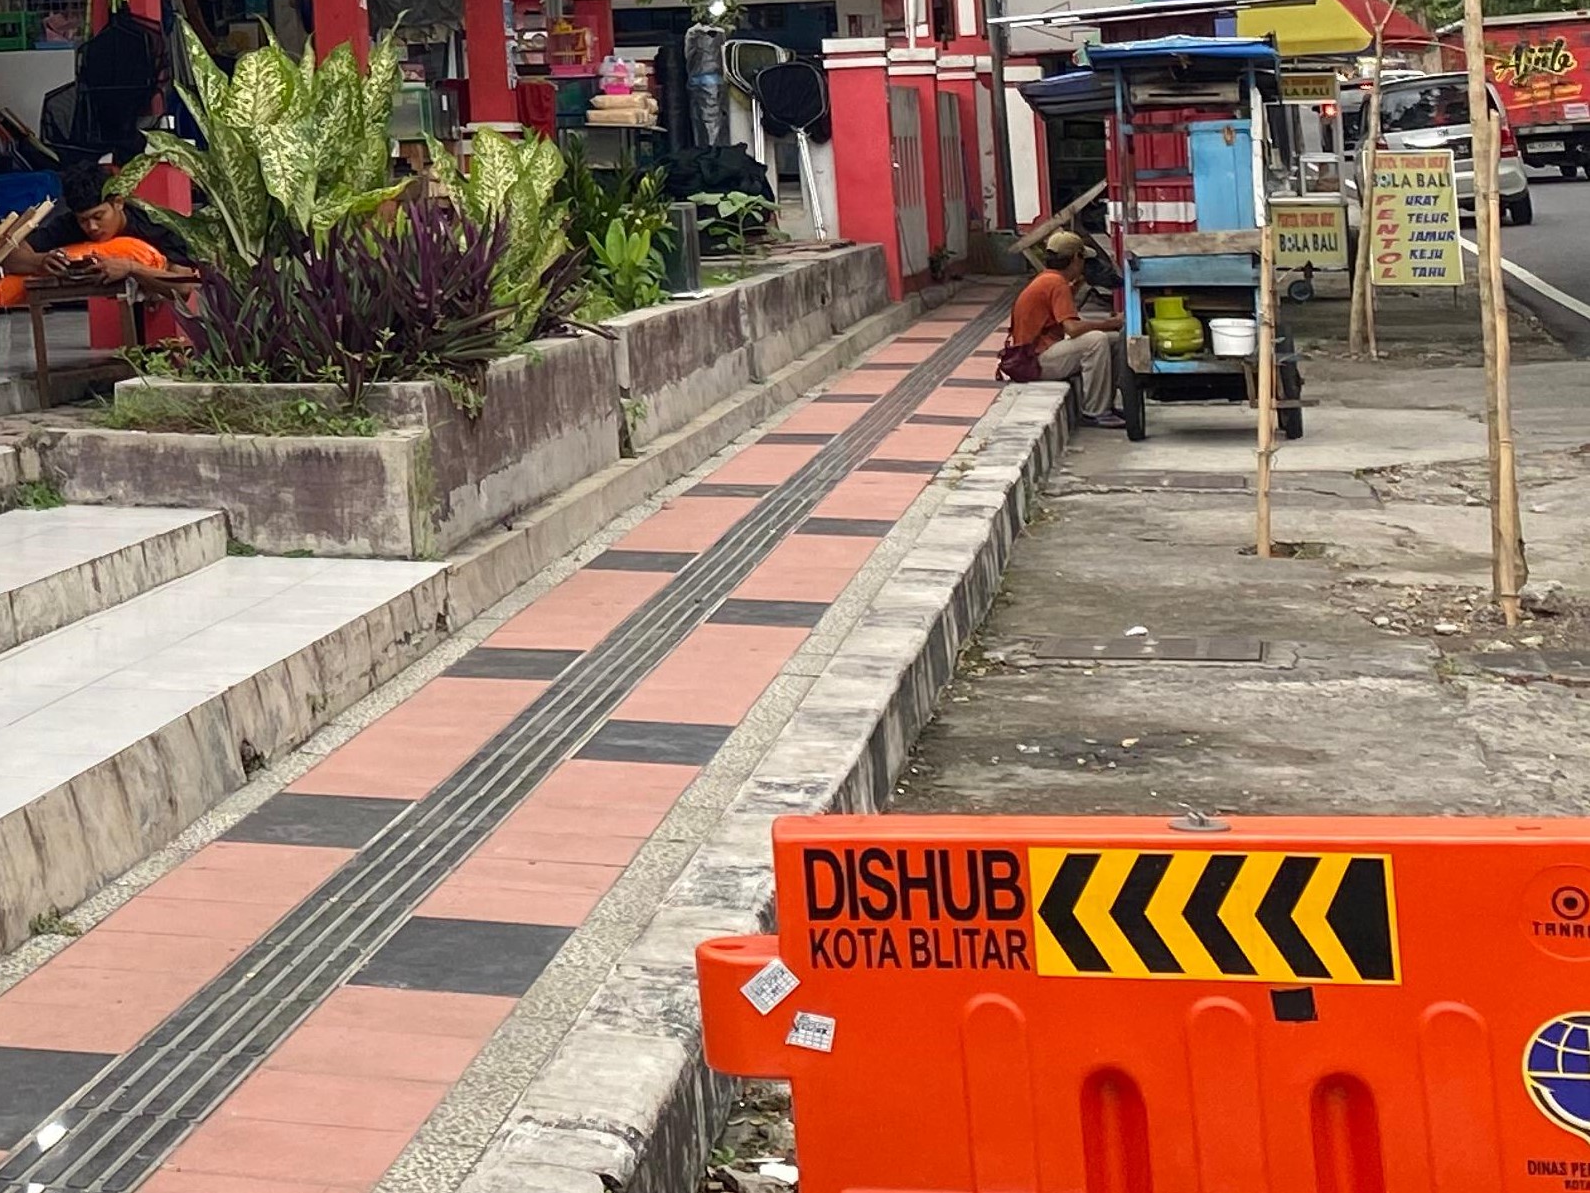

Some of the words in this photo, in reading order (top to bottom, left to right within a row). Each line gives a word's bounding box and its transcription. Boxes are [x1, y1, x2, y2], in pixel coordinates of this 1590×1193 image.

[1416, 172, 1452, 188] BALI
[1405, 195, 1439, 206] URAT
[1407, 212, 1449, 223] TELUR
[1312, 231, 1338, 252] BALI
[1408, 230, 1456, 242] JAMUR
[1409, 248, 1444, 260] KEJU
[1411, 266, 1447, 278] TAHU
[803, 847, 1026, 922] DISHUB
[809, 927, 902, 970] KOTA
[909, 927, 1031, 971] BLITAR
[1527, 1159, 1568, 1176] DINAS
